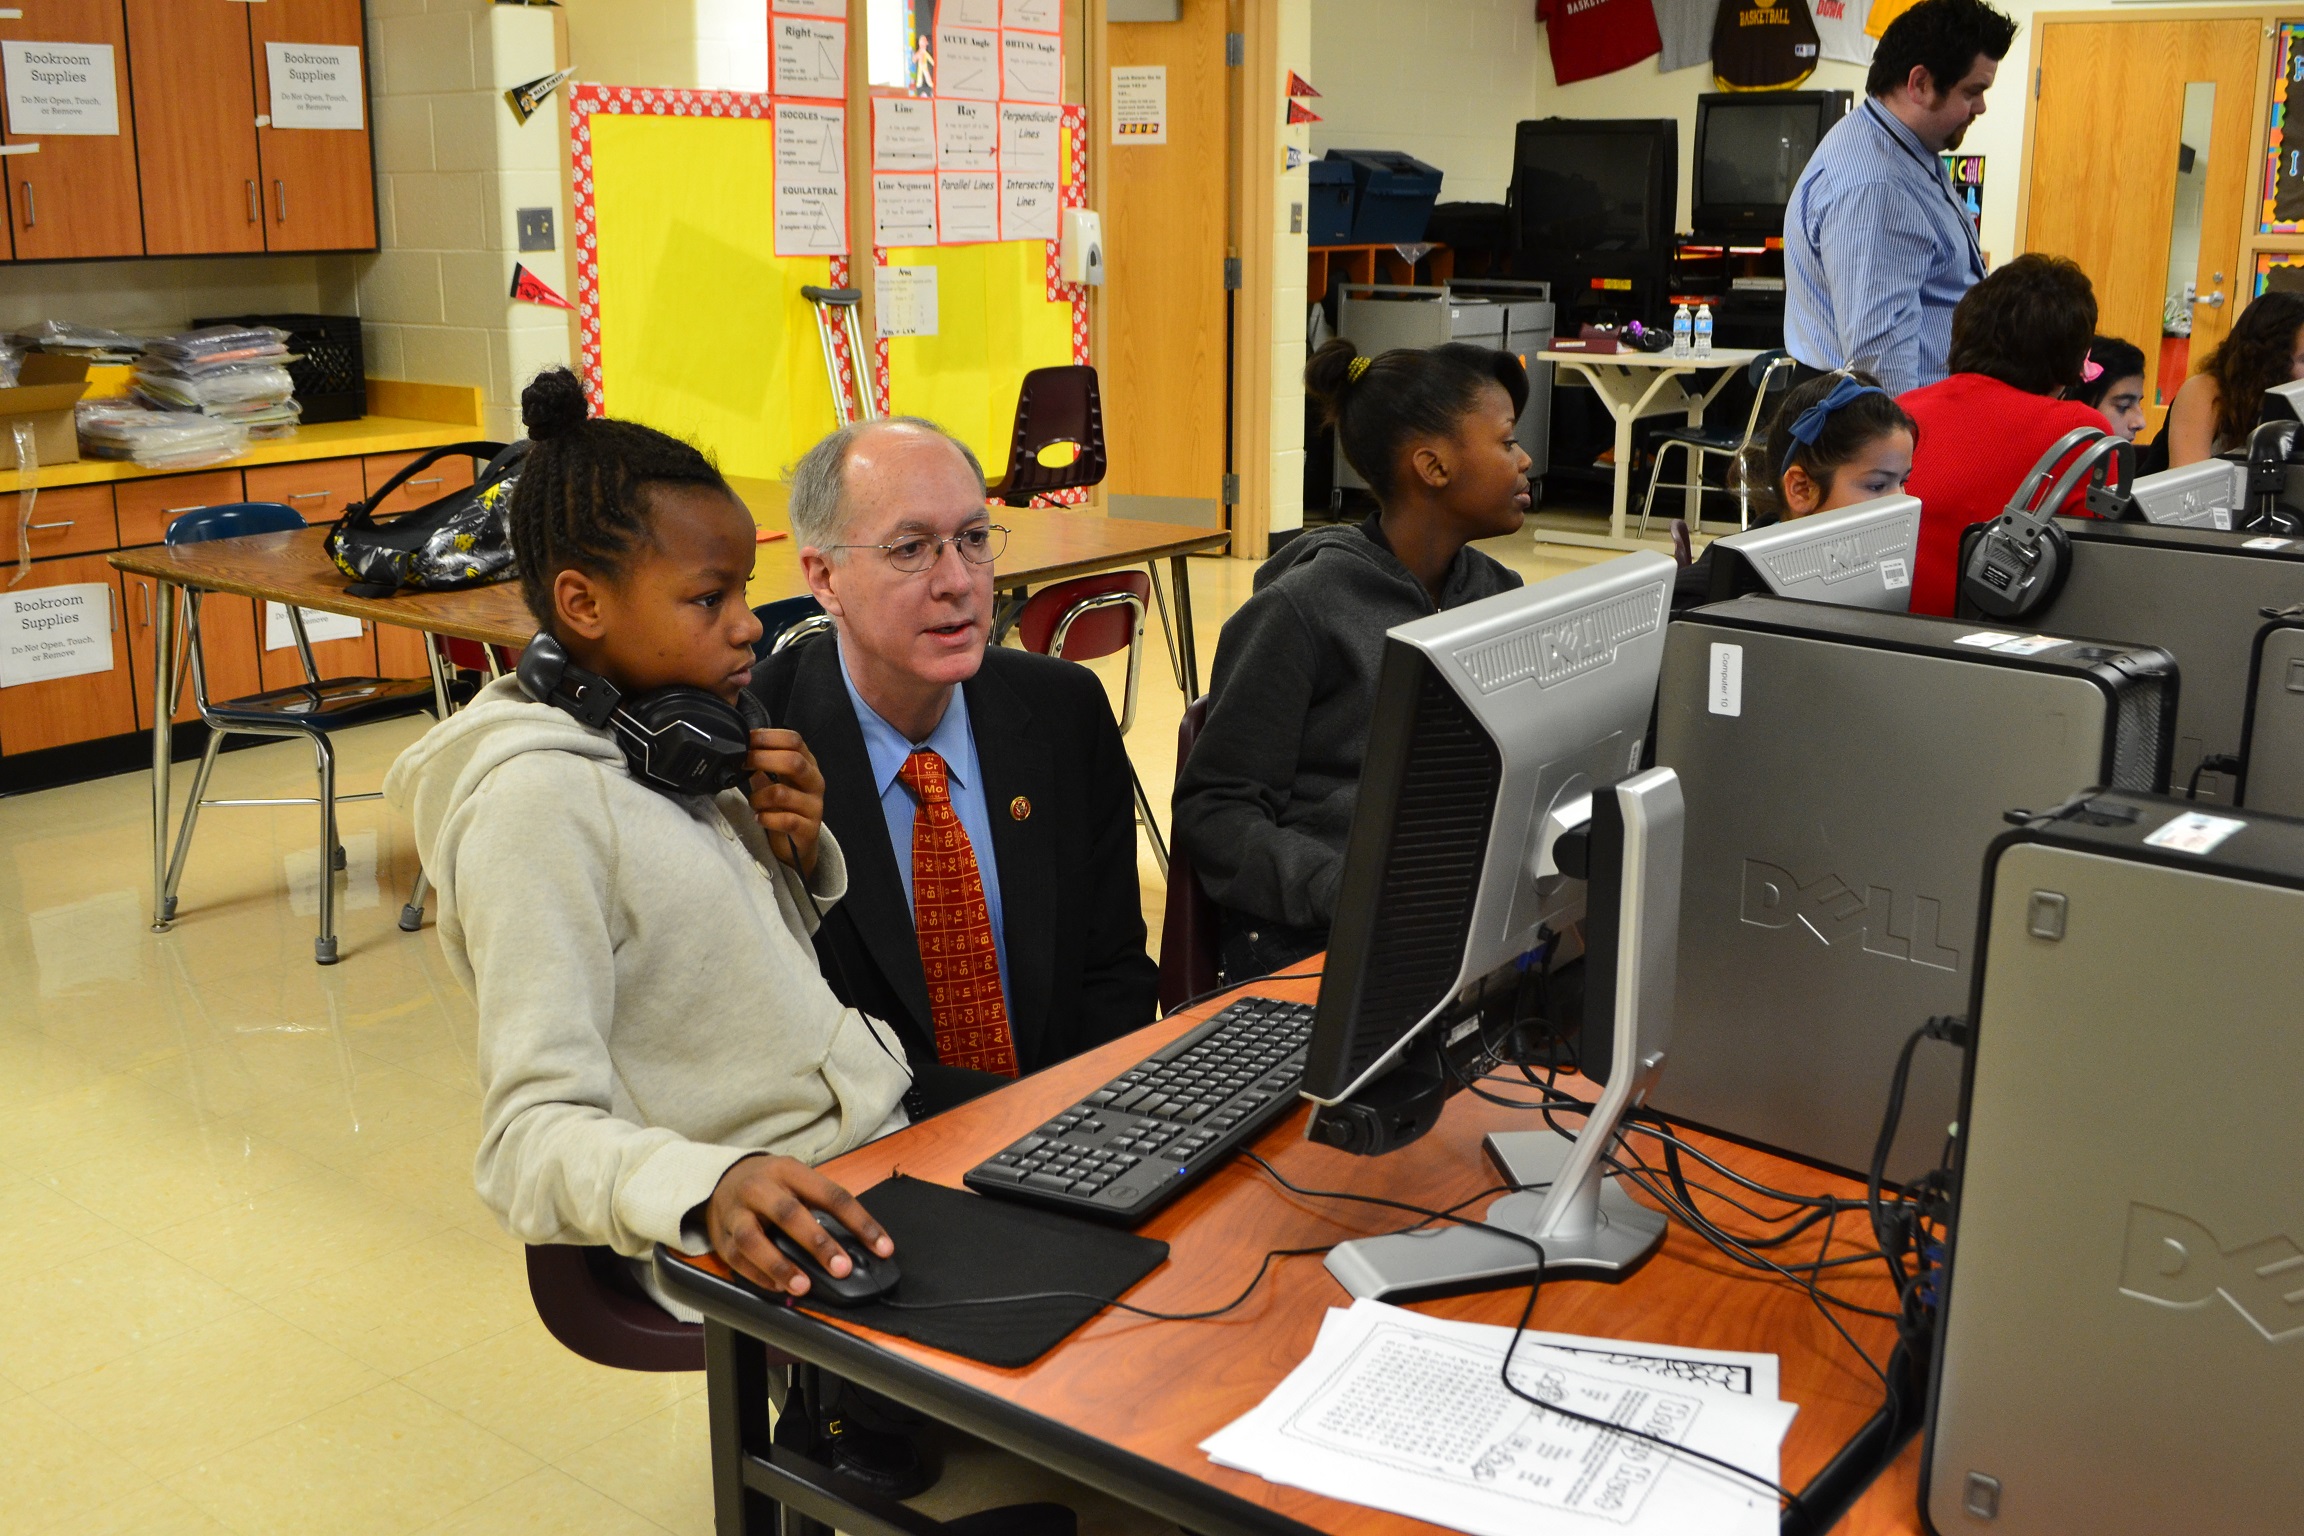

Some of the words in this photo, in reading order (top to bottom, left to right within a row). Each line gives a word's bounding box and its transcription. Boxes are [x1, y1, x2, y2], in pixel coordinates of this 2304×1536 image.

[1740, 8, 1790, 27] BASKETBALL
[785, 26, 811, 39] Right
[971, 38, 990, 48] Angle
[1037, 44, 1055, 53] Angle
[24, 51, 91, 65] Bookroom
[284, 52, 340, 65] Bookroom
[31, 70, 87, 85] Supplies
[289, 69, 336, 83] Supplies
[21, 96, 32, 104] Do
[34, 96, 48, 104] Not
[50, 97, 73, 106] Open,
[75, 97, 101, 106] Touch,
[281, 93, 290, 101] Do
[291, 93, 302, 101] Not
[305, 103, 332, 111] Remove
[894, 103, 914, 114] Line
[957, 105, 977, 119] Ray
[779, 111, 819, 121] ISOCOLES
[1002, 110, 1058, 124] Perpendicular
[1018, 128, 1040, 139] Lines
[783, 186, 838, 196] EQUILATERAL
[878, 181, 895, 190] Line
[897, 181, 932, 192] Segment
[941, 179, 970, 191] Parallel
[974, 180, 995, 191] Lines
[1006, 179, 1055, 193] Intersecting
[1016, 196, 1037, 207] Lines
[14, 595, 84, 613] Bookroom
[22, 613, 80, 631] Supplies
[11, 646, 23, 655] Do
[25, 644, 39, 653] Not
[40, 641, 66, 652] Open,
[67, 635, 95, 647] Touch,
[43, 649, 76, 660] Remove
[1720, 652, 1730, 694] Computer
[1720, 697, 1728, 708] 10
[924, 761, 939, 770] Cr
[925, 784, 944, 794] Mo
[941, 805, 949, 820] Sr
[925, 834, 931, 843] K
[944, 830, 954, 848] Rb
[925, 857, 934, 872] Kr
[947, 857, 957, 873] Xe
[926, 885, 936, 899] Br
[973, 878, 982, 893] At
[929, 910, 938, 926] Se
[954, 909, 963, 925] Te
[977, 903, 986, 920] Po
[1741, 858, 1960, 972] DELL
[931, 936, 941, 953] As
[956, 934, 966, 950] Sb
[980, 931, 989, 945] Bi
[959, 960, 969, 976] Sn
[984, 954, 993, 970] Pb
[933, 962, 943, 978] Ge
[935, 987, 945, 1003] Ga
[962, 987, 972, 998] In
[964, 1008, 974, 1024] Cd
[991, 1002, 1001, 1019] Hg
[938, 1012, 948, 1027] Zn
[968, 1031, 979, 1047] Ag
[993, 1027, 1004, 1043] Au
[942, 1035, 952, 1051] Cu
[971, 1055, 981, 1071] Pd
[997, 1052, 1007, 1065] Pt
